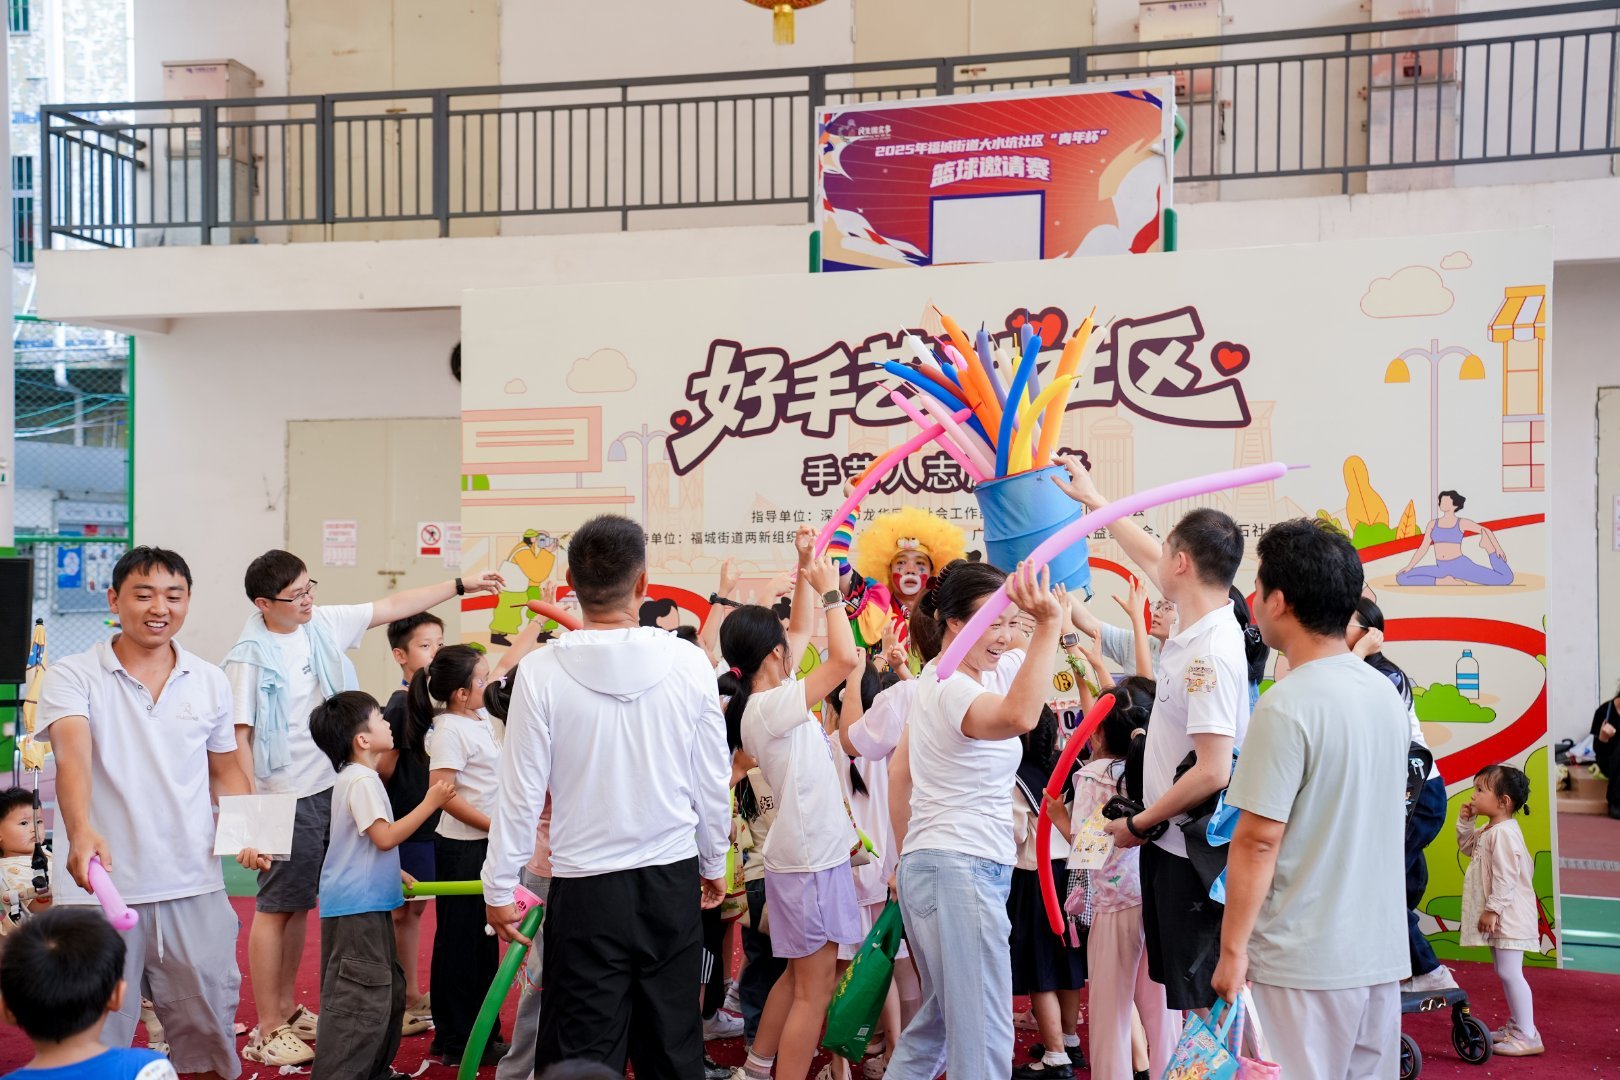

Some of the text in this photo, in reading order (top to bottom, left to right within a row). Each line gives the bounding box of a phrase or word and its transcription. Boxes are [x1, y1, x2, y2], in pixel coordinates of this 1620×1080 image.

[929, 154, 1052, 189] 篮球邀请赛
